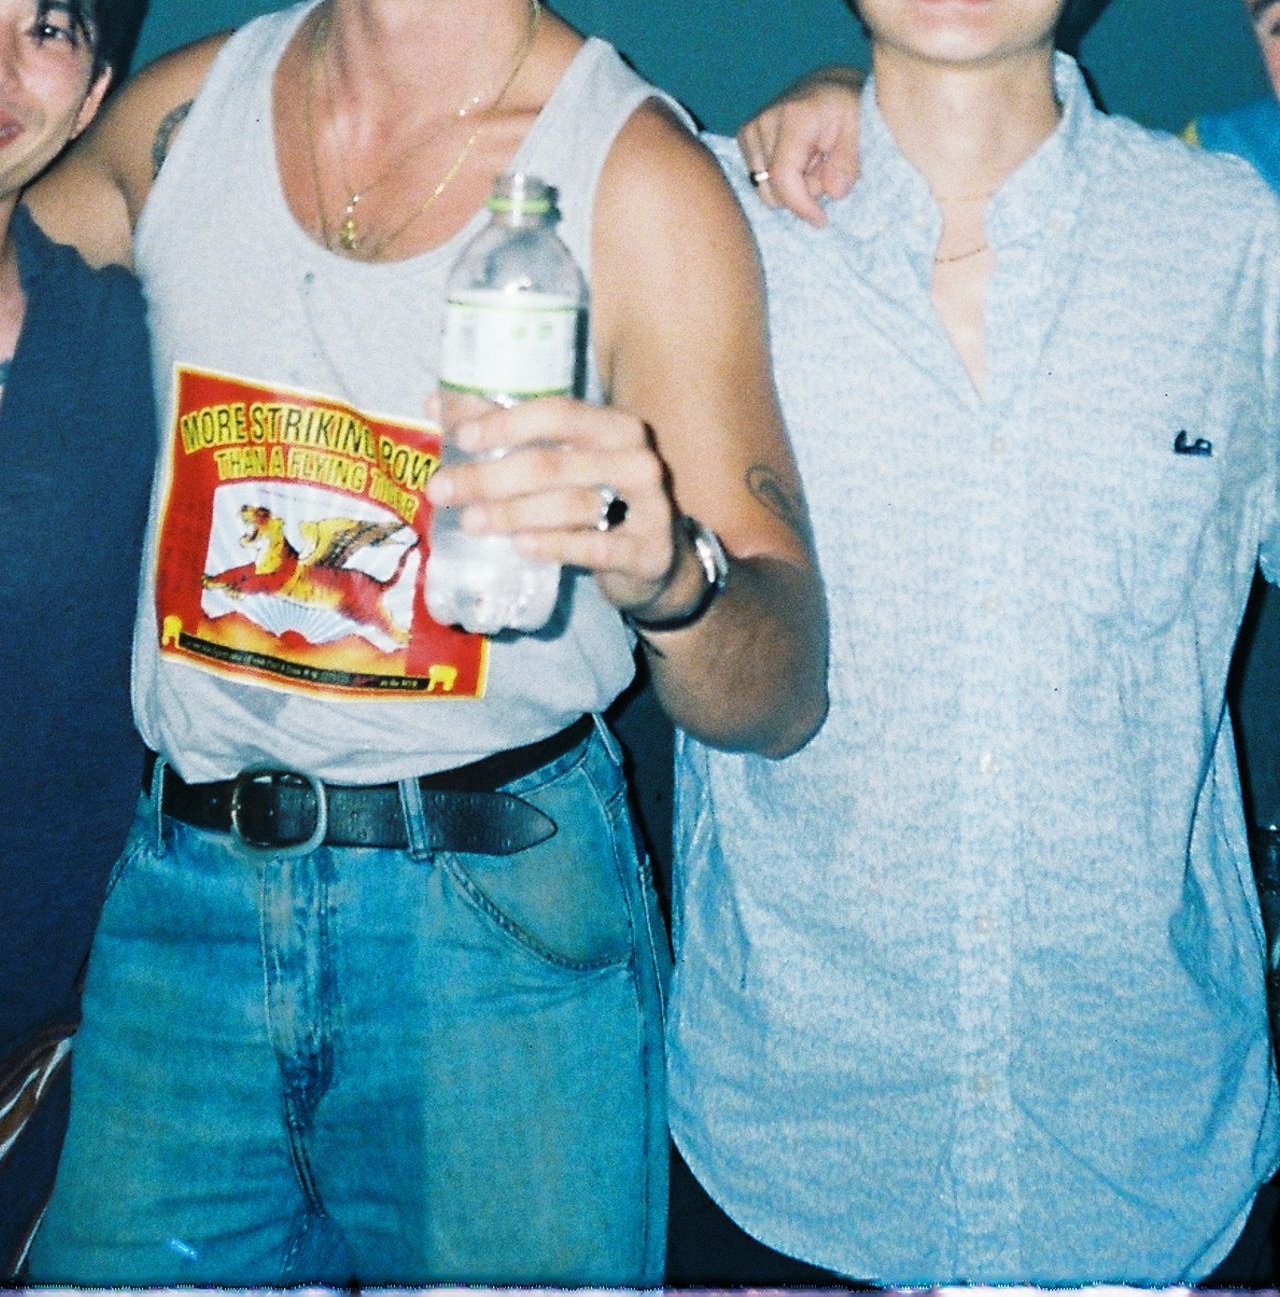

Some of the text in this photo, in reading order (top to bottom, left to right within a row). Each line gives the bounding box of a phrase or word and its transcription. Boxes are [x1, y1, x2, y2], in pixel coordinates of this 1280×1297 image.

[182, 404, 247, 452] MORE
[380, 437, 440, 489] POW
[215, 448, 266, 479] THAN
[269, 447, 284, 478] A
